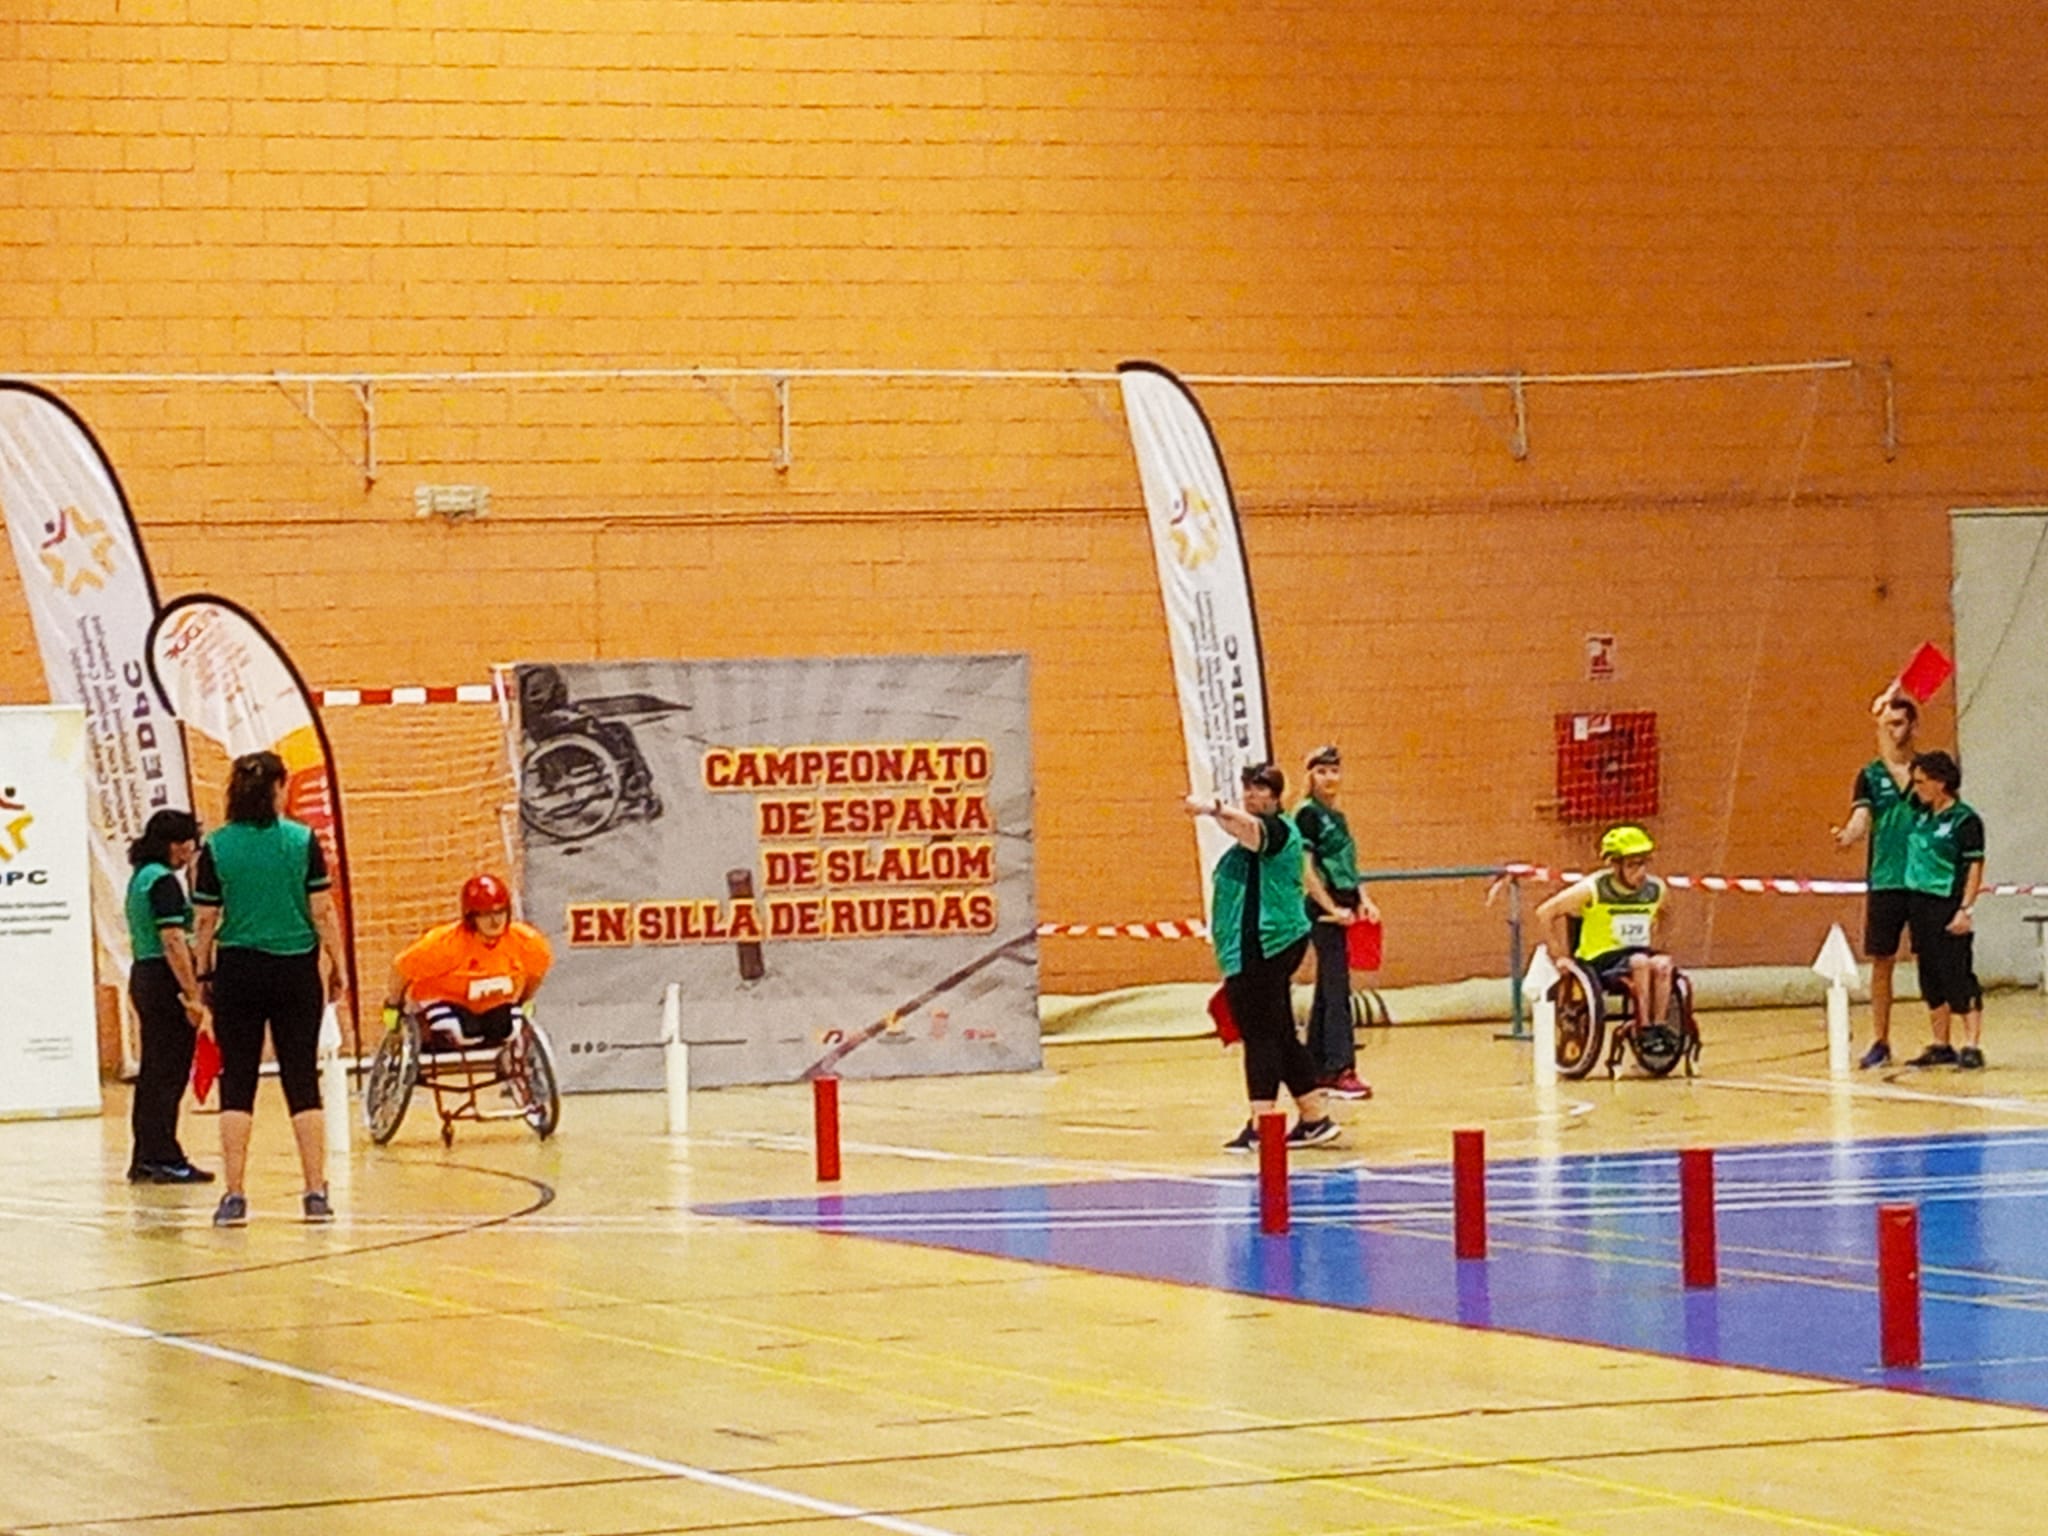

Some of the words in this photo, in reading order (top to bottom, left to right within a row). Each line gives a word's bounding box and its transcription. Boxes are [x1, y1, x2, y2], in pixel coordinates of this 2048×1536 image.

[704, 746, 989, 788] CAMPEONATO
[760, 801, 812, 835] DE
[821, 787, 990, 834] ESPAÑA
[0, 869, 48, 886] PC
[765, 852, 817, 887] DE
[827, 845, 991, 884] SLALOM
[570, 908, 627, 943] EN
[637, 904, 760, 940] SILLA
[770, 900, 824, 936] DE
[830, 896, 993, 934] RUEDAS
